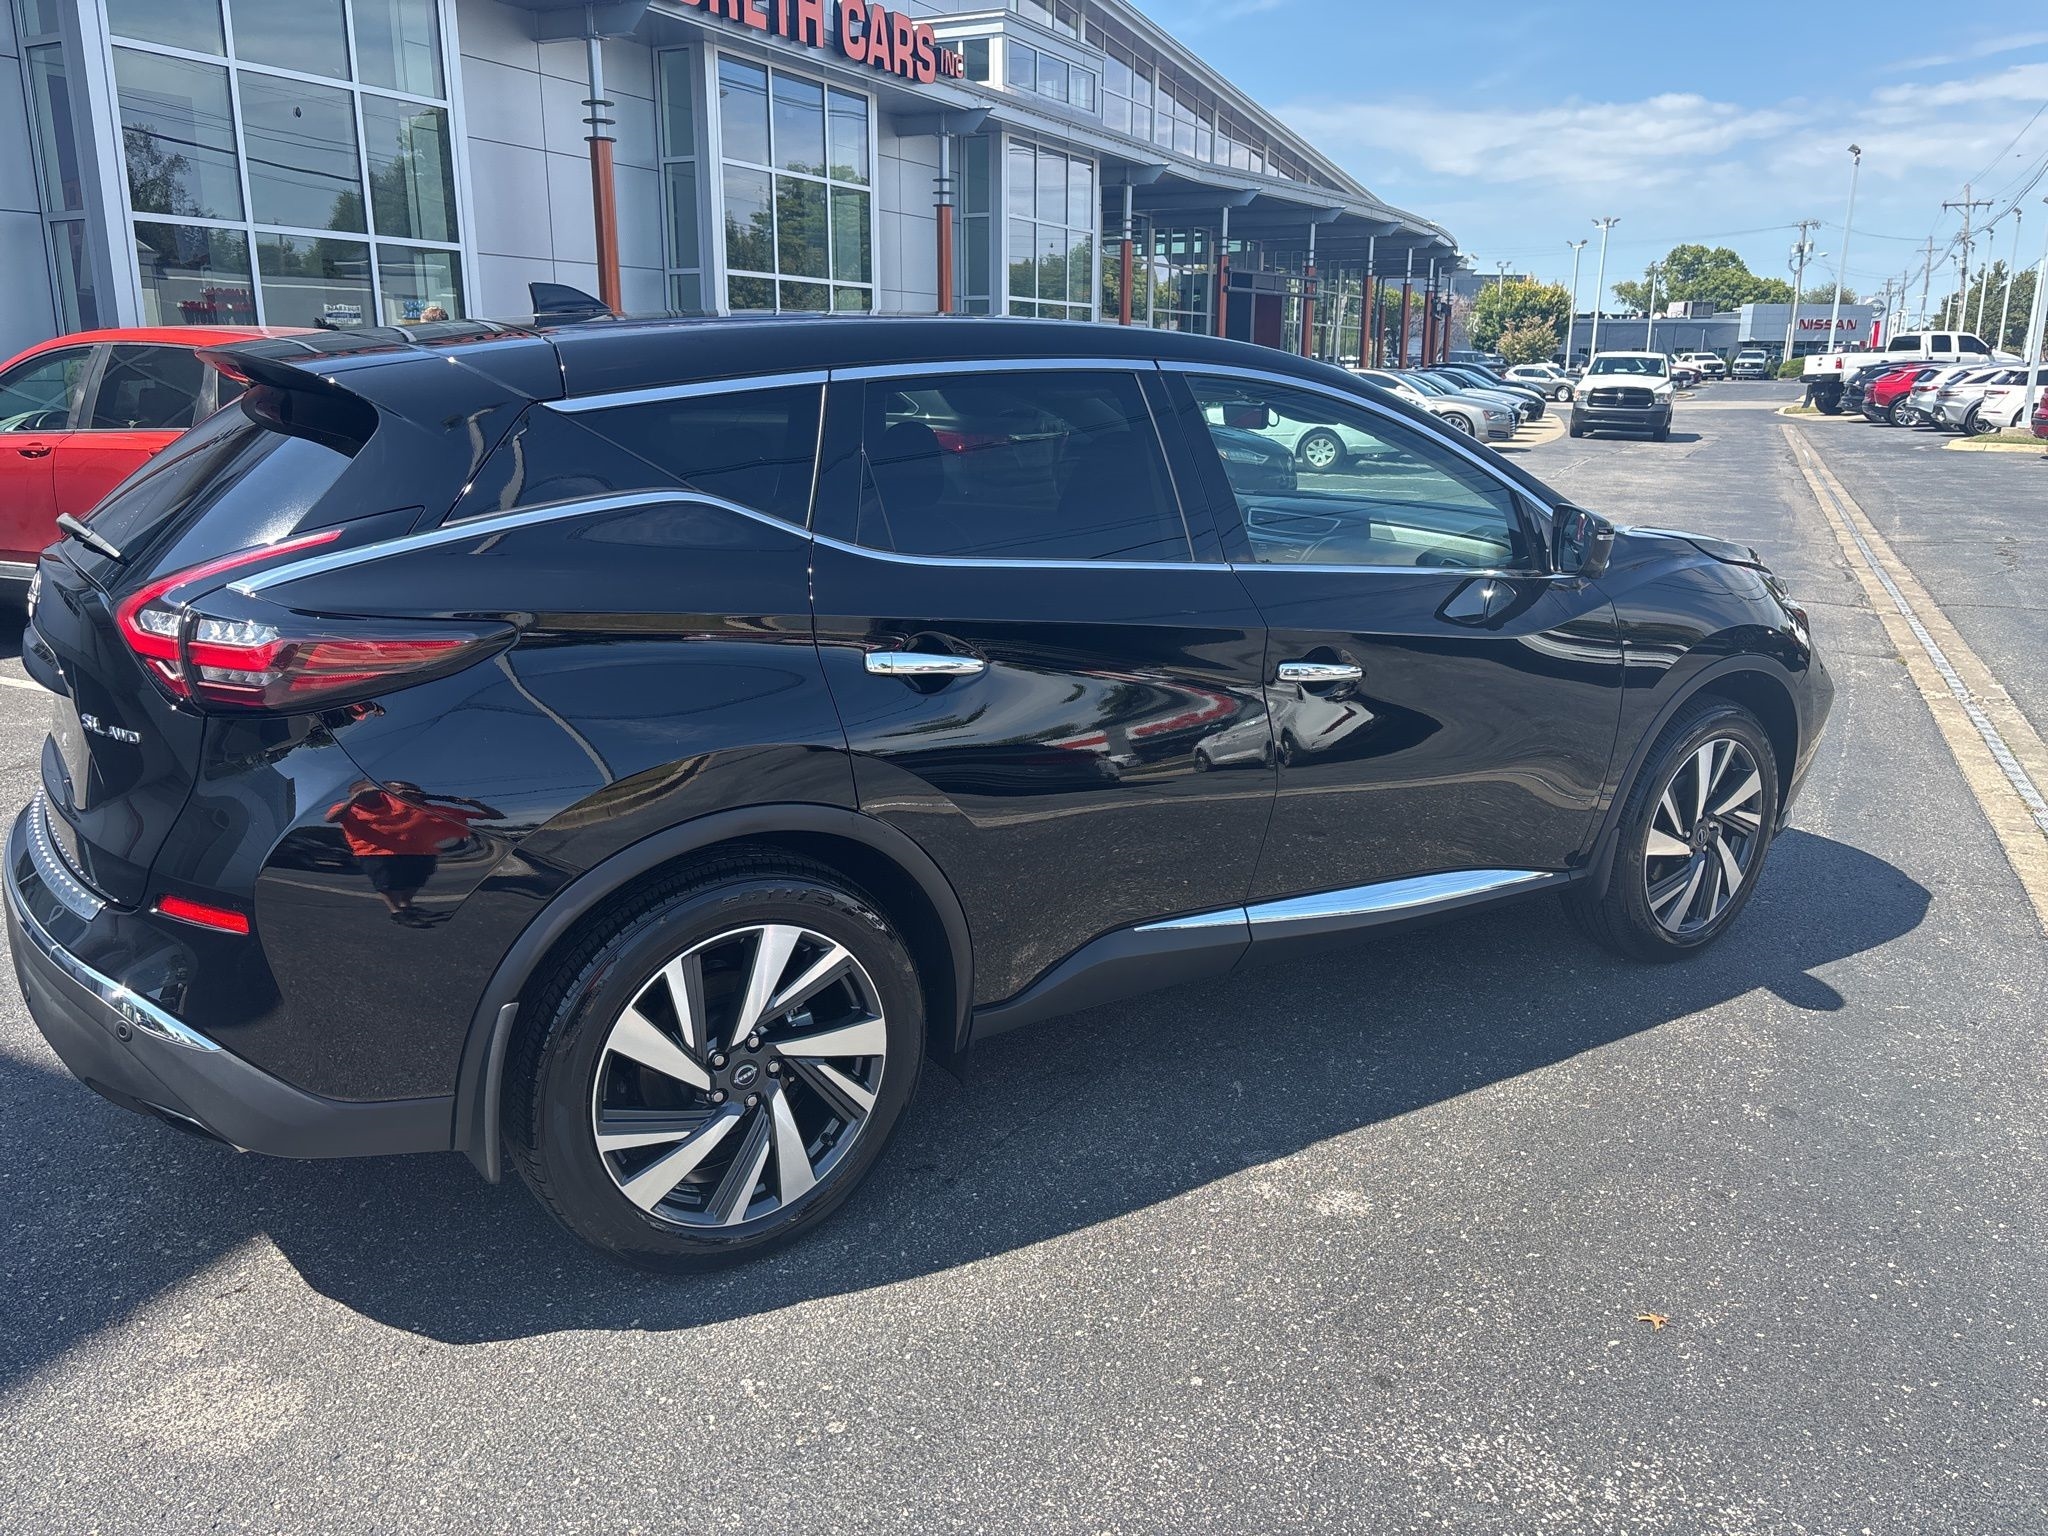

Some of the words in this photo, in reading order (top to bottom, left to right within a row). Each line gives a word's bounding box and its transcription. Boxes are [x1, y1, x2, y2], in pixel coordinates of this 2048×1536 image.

[841, 0, 936, 84] CARS
[1798, 318, 1857, 331] NISSAN
[81, 713, 105, 736] SL
[108, 725, 141, 744] AWD
